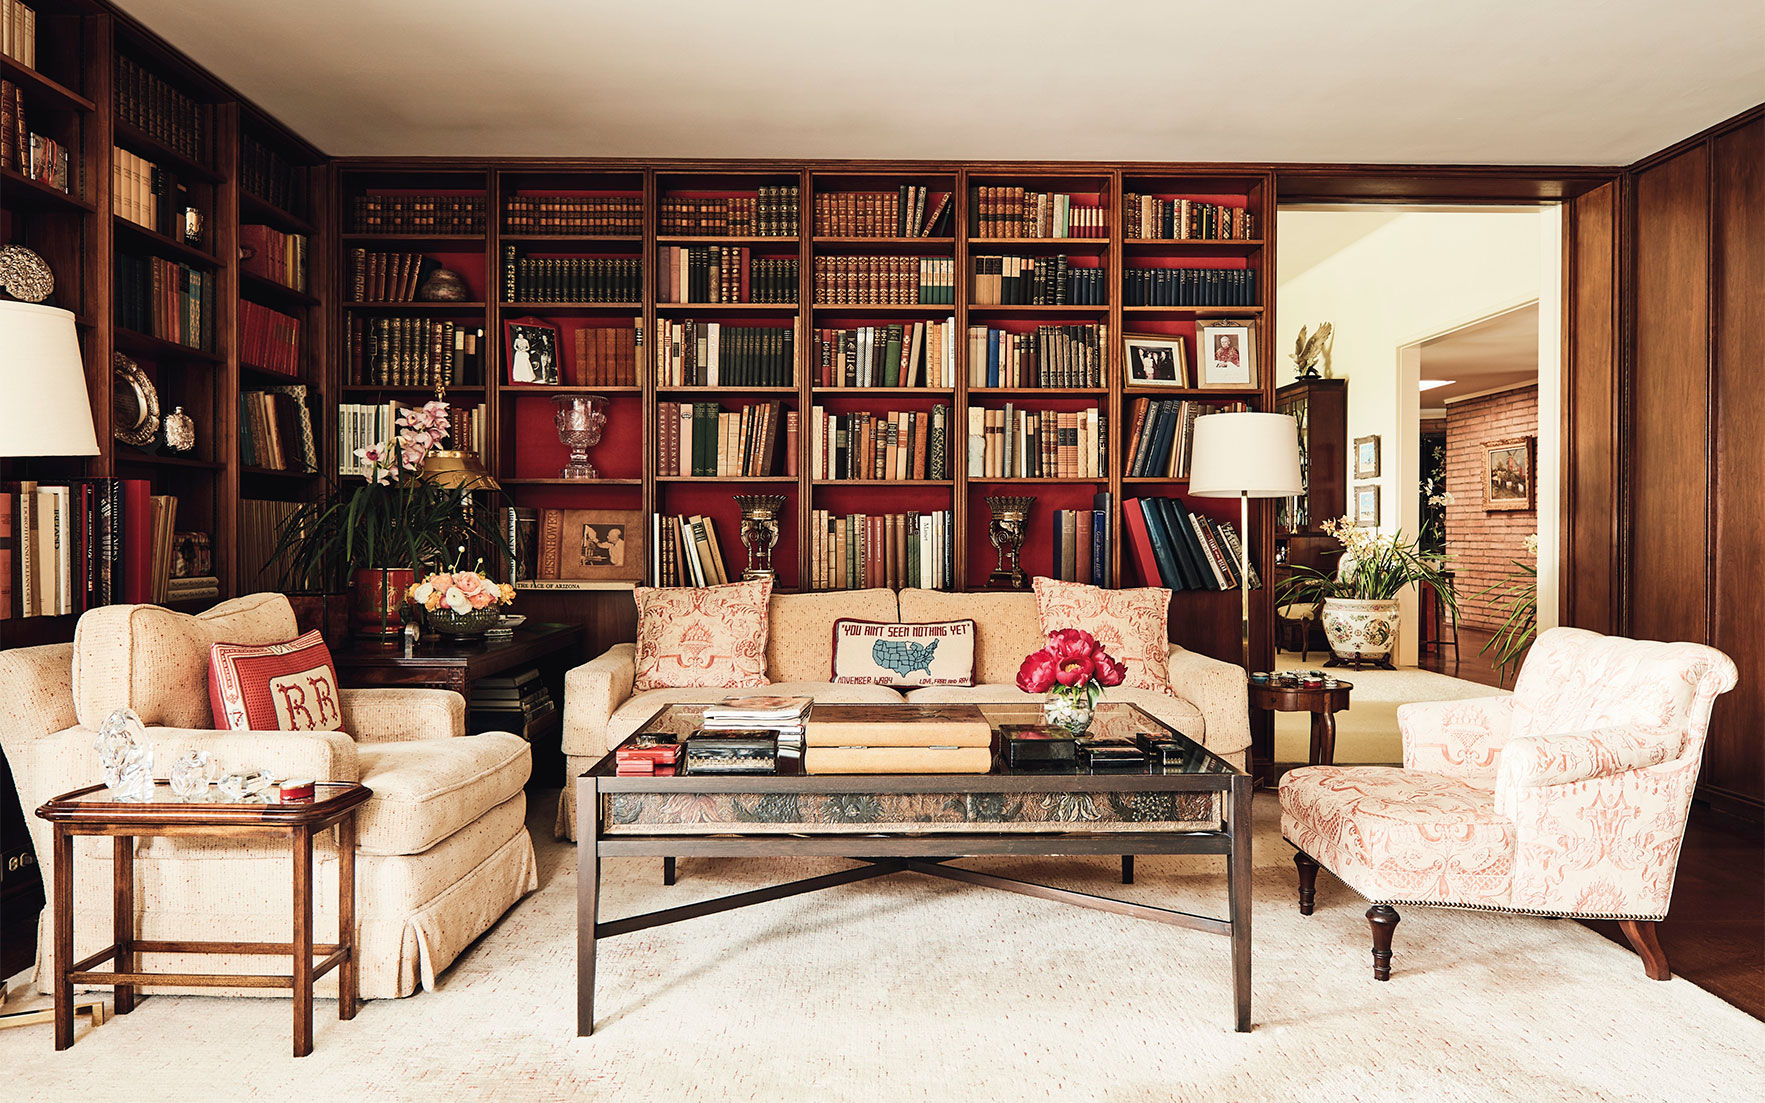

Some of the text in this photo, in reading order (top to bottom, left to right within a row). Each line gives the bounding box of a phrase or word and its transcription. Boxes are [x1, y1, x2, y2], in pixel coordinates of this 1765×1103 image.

[544, 511, 558, 576] EISENHOWER
[888, 626, 909, 637] SEEN
[913, 626, 947, 637] NOTHING
[838, 676, 871, 685] NOVEMBER
